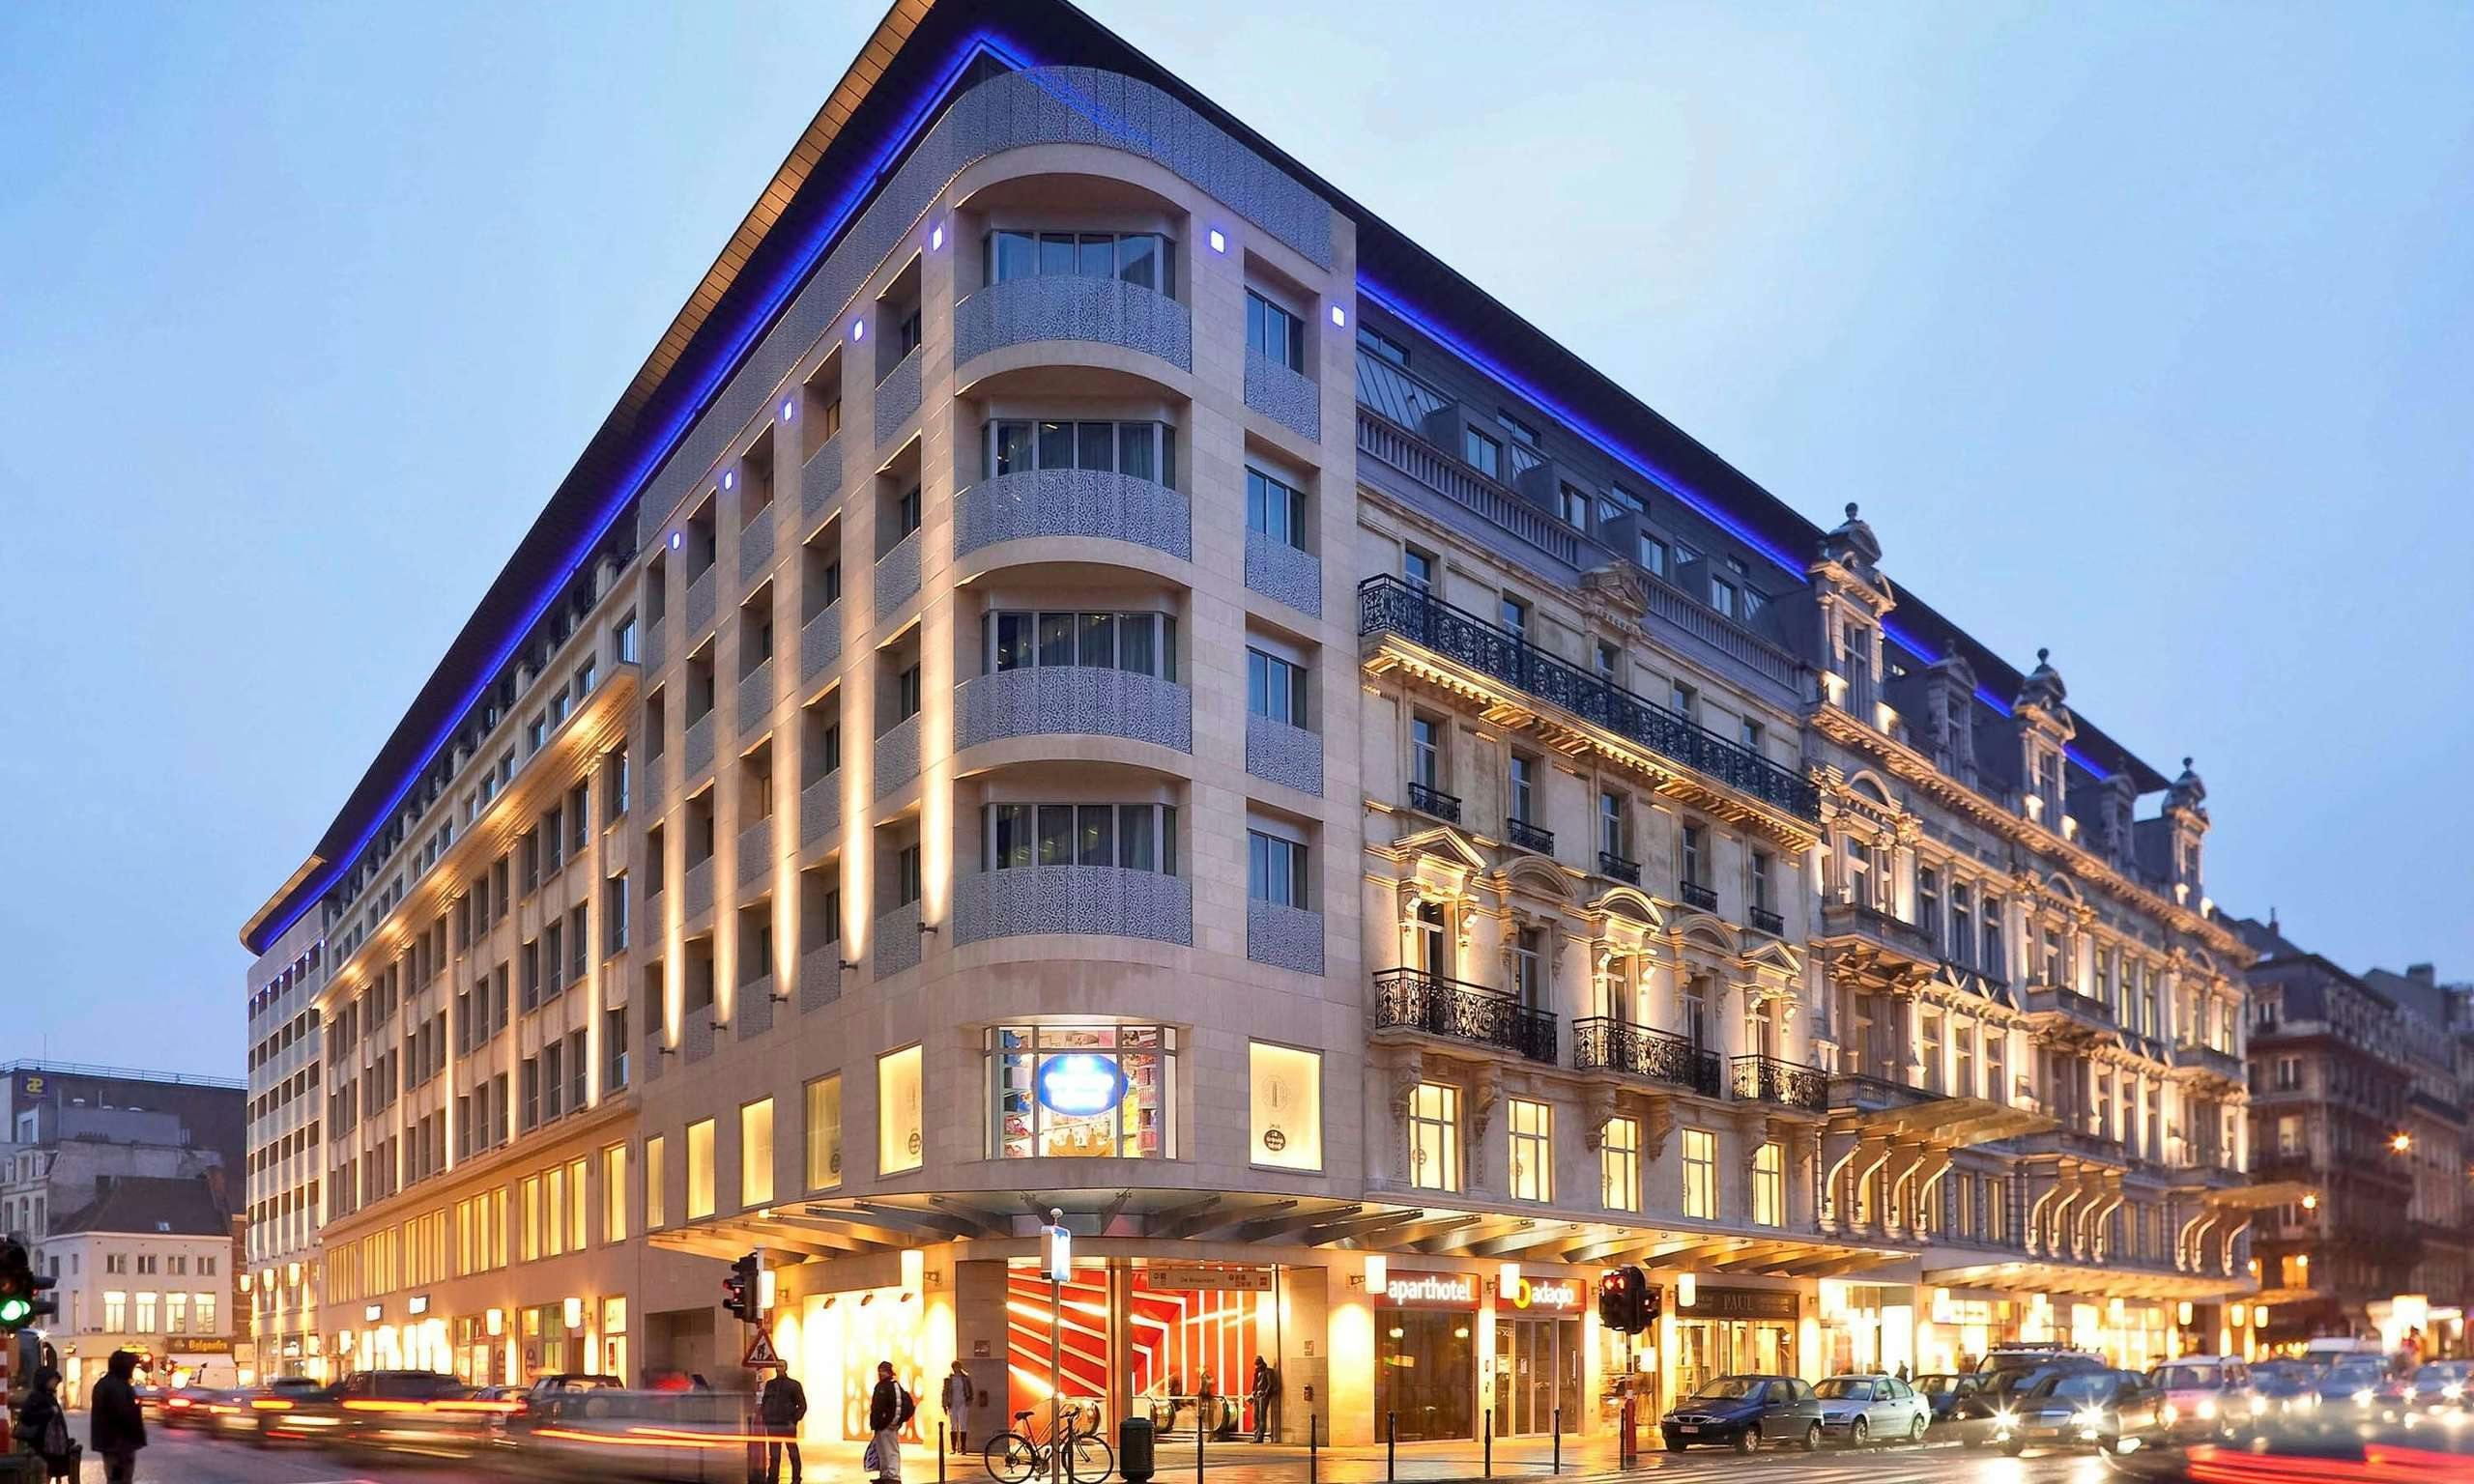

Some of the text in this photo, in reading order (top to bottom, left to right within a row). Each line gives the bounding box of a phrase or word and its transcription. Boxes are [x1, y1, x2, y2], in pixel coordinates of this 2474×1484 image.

[1388, 1276, 1471, 1305] aparthotel
[1532, 1282, 1573, 1309] adagio
[1723, 1296, 1754, 1311] PAUL
